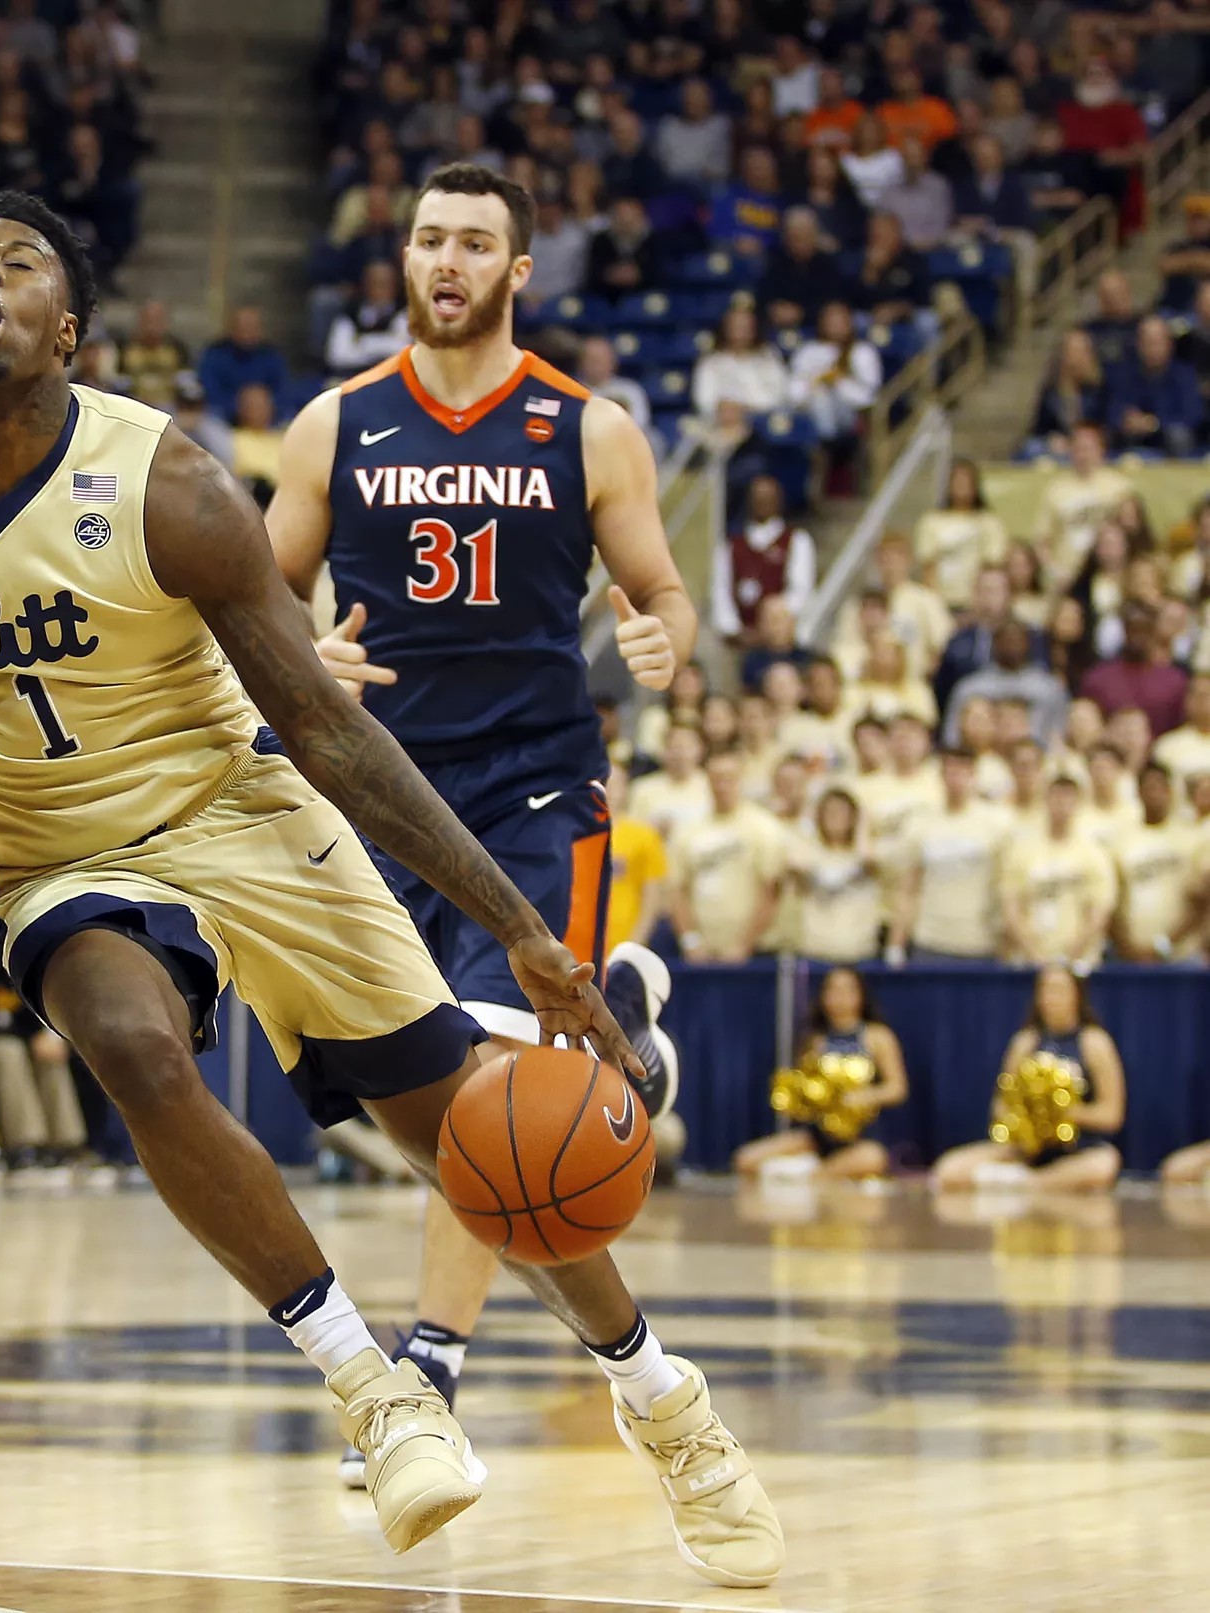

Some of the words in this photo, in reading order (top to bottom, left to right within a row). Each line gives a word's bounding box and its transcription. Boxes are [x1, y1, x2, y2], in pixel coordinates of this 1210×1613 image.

[354, 465, 556, 510] VIRGINIA
[80, 525, 108, 534] ACC
[406, 517, 501, 605] 31
[12, 673, 82, 759] 1
